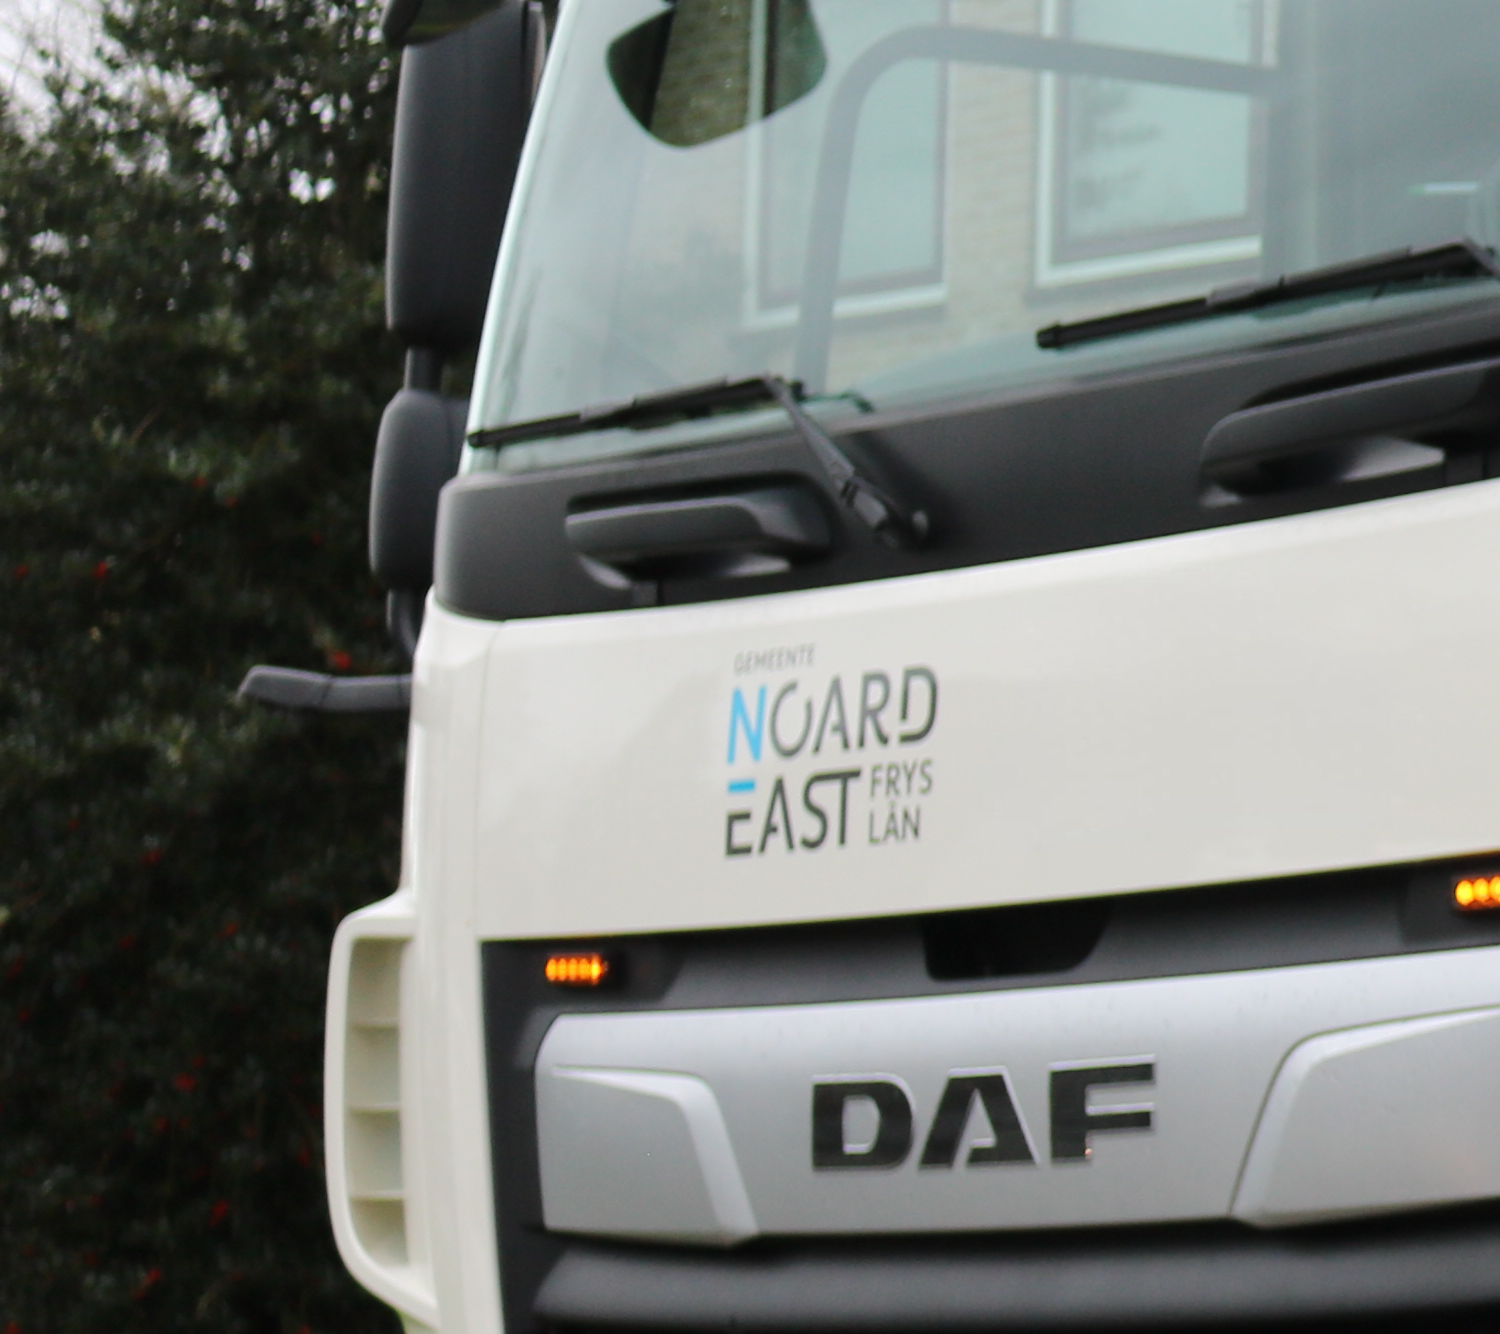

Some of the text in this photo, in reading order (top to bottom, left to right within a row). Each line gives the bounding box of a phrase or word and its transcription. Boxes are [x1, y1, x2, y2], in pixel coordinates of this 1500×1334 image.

[733, 642, 816, 676] GEMEENTE
[727, 666, 938, 764] NOARD
[724, 758, 934, 857] EAST FRYS
[811, 1054, 1157, 1170] DAF
